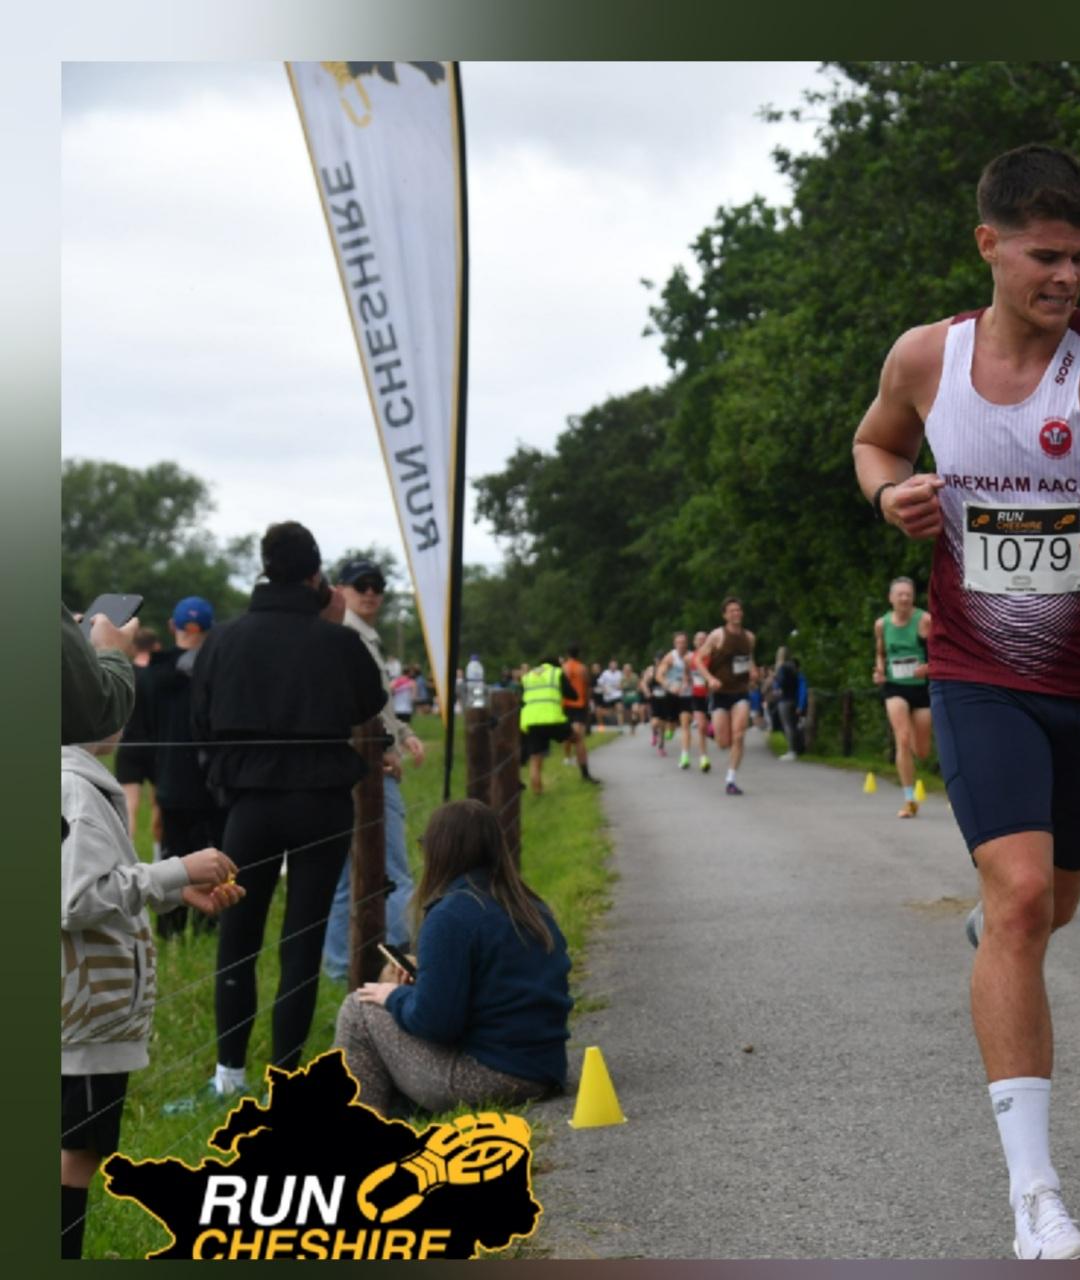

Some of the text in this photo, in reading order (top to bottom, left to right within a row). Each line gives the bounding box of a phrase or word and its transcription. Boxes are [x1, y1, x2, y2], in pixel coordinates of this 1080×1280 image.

[1037, 477, 1078, 493] AAC
[996, 511, 1025, 522] RUN
[979, 535, 1072, 572] 1079
